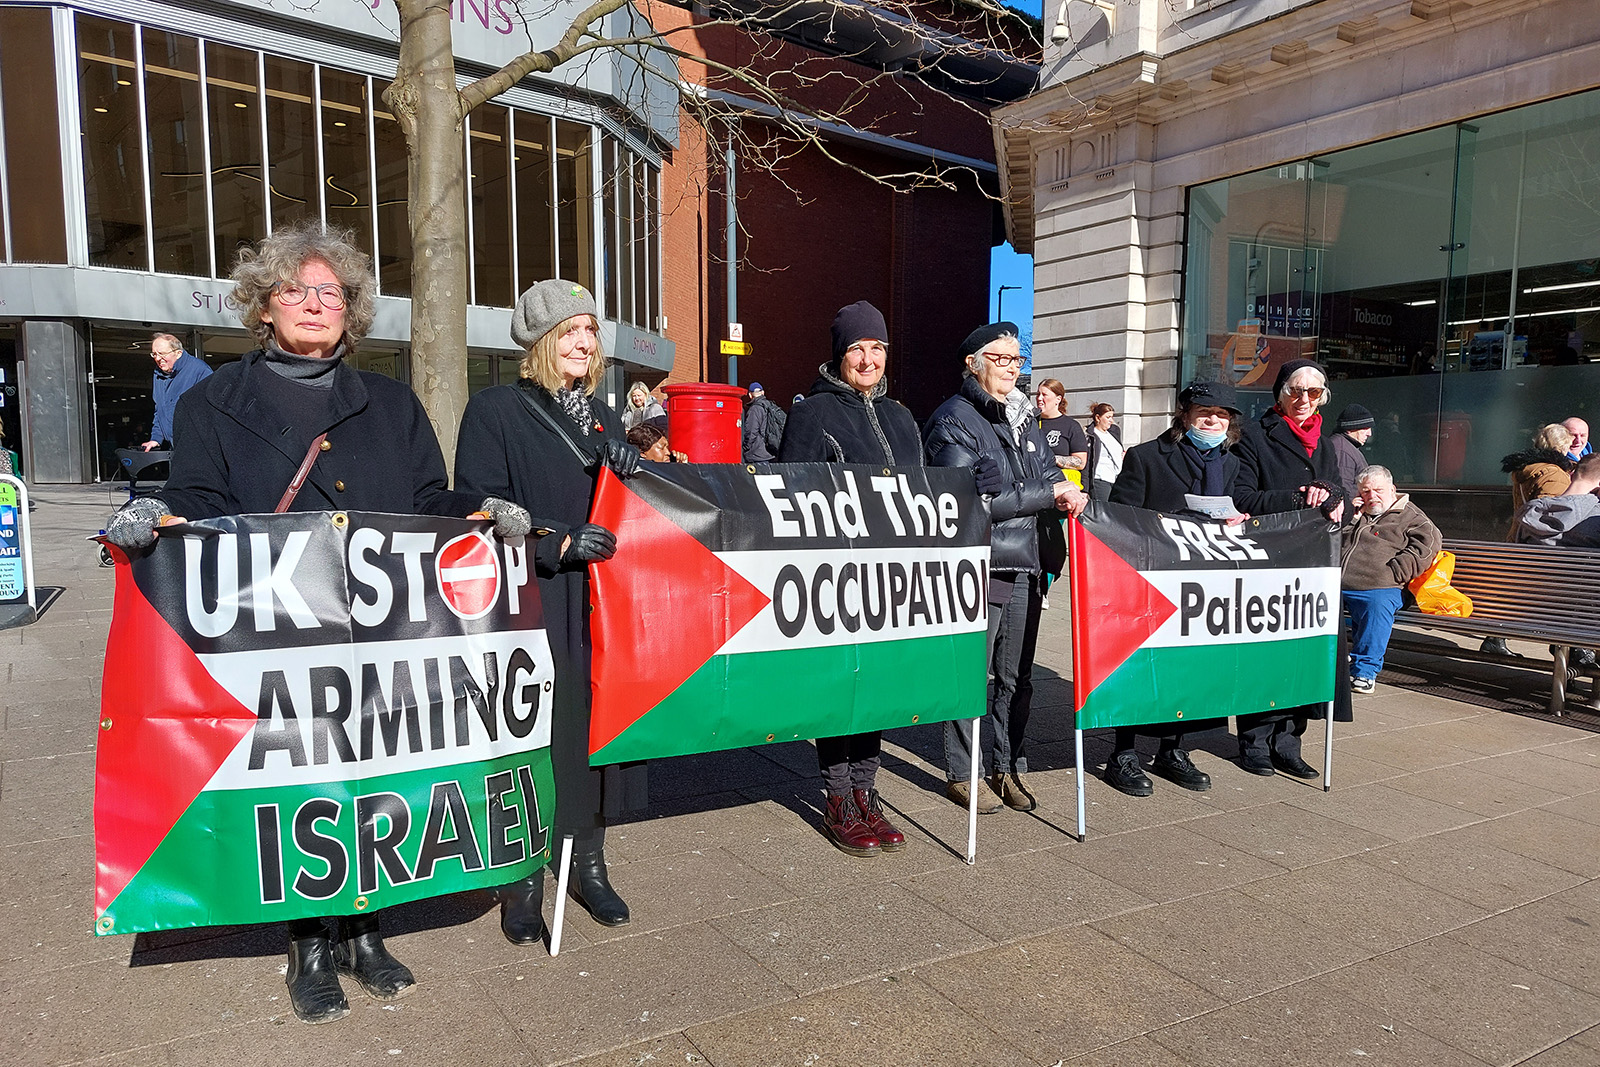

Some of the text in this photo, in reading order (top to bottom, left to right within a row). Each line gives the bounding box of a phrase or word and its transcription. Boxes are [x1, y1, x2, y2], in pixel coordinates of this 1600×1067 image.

[1353, 307, 1393, 326] Tobacco
[754, 470, 959, 539] End The
[0, 547, 17, 556] AIT
[1160, 517, 1269, 561] FREE
[184, 527, 528, 638] UK STOP
[1180, 577, 1328, 636] Palestine
[247, 647, 540, 771] ARMING
[254, 764, 549, 904] ISRAEL
